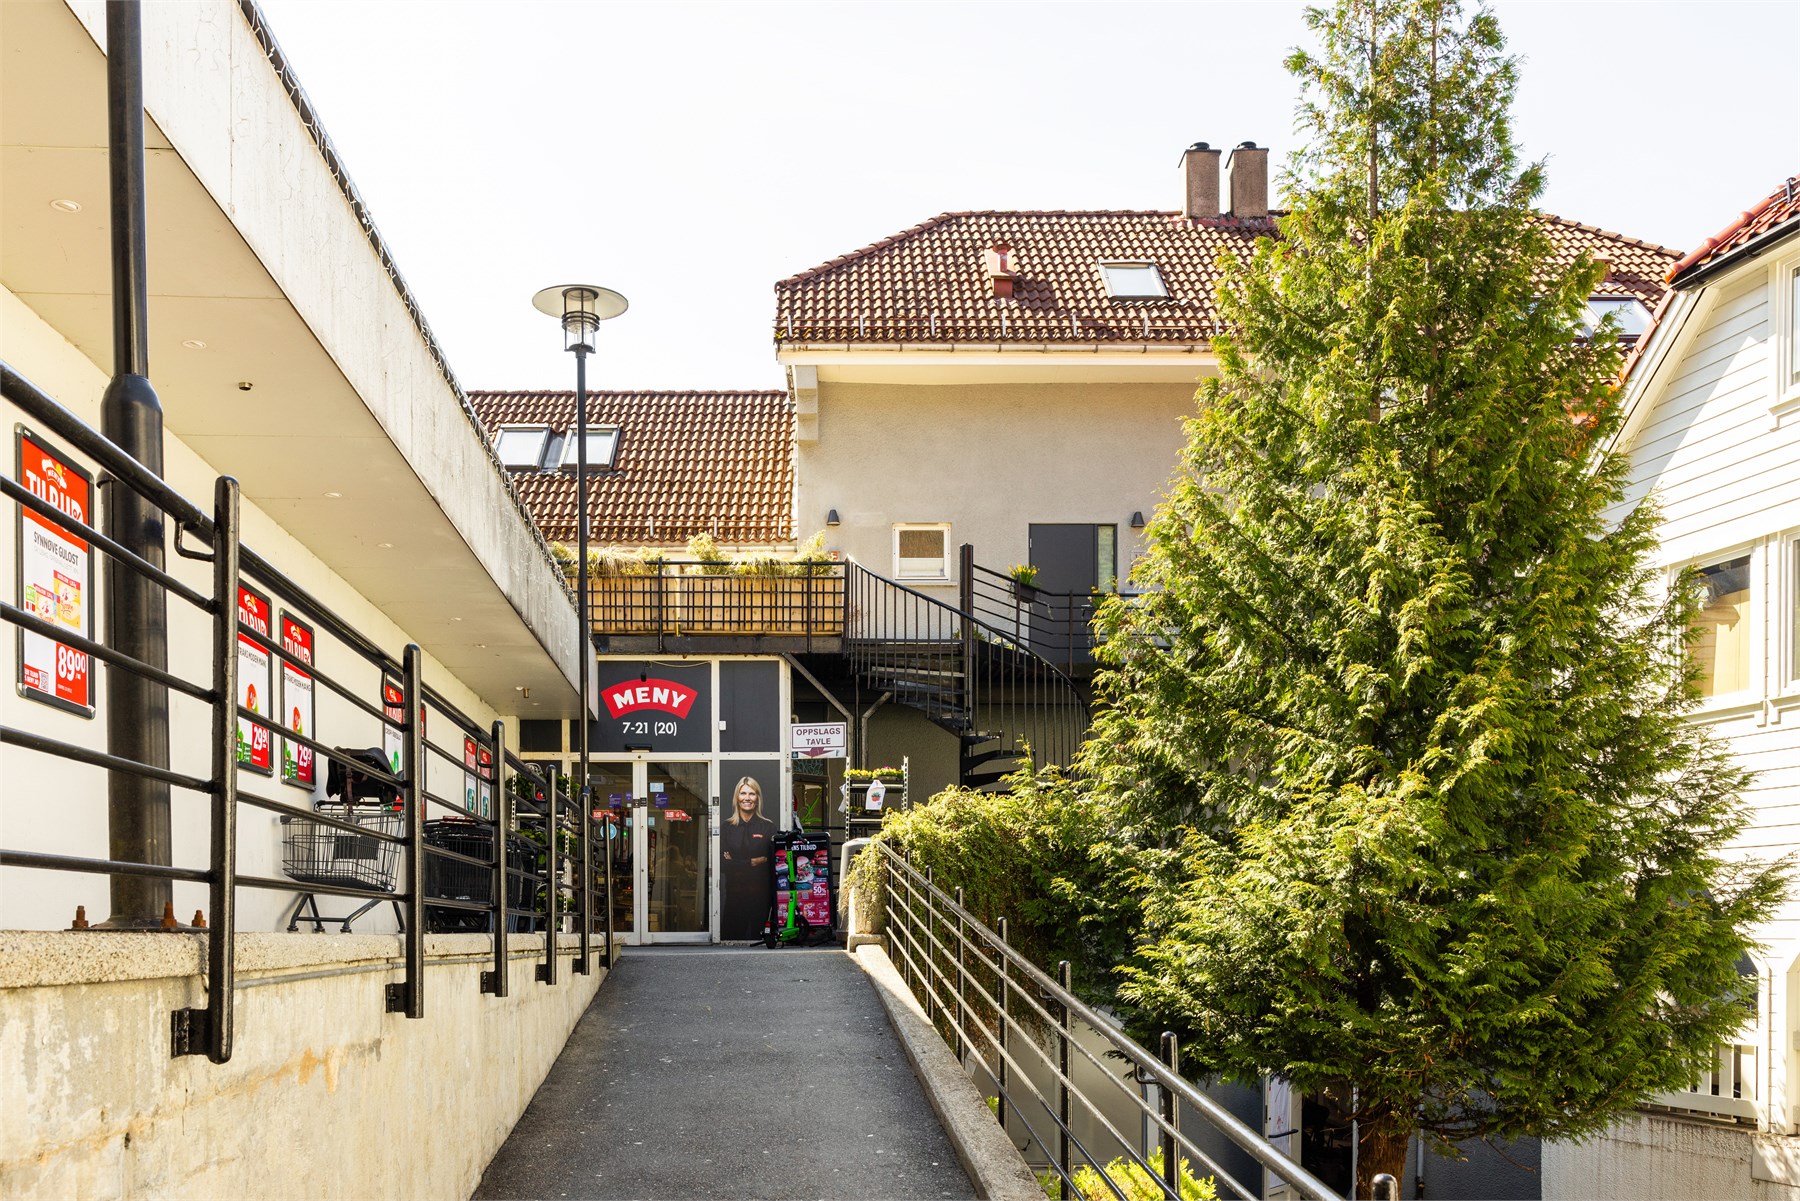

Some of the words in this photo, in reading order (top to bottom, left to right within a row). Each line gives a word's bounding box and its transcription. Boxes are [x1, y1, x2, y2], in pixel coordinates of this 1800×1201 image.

[33, 531, 58, 555] SYNNØVE
[58, 545, 79, 567] GULOST
[612, 686, 687, 709] MENY
[622, 721, 648, 734] 7-21
[654, 721, 677, 736] (20)
[796, 727, 841, 736] OPPSLAGS
